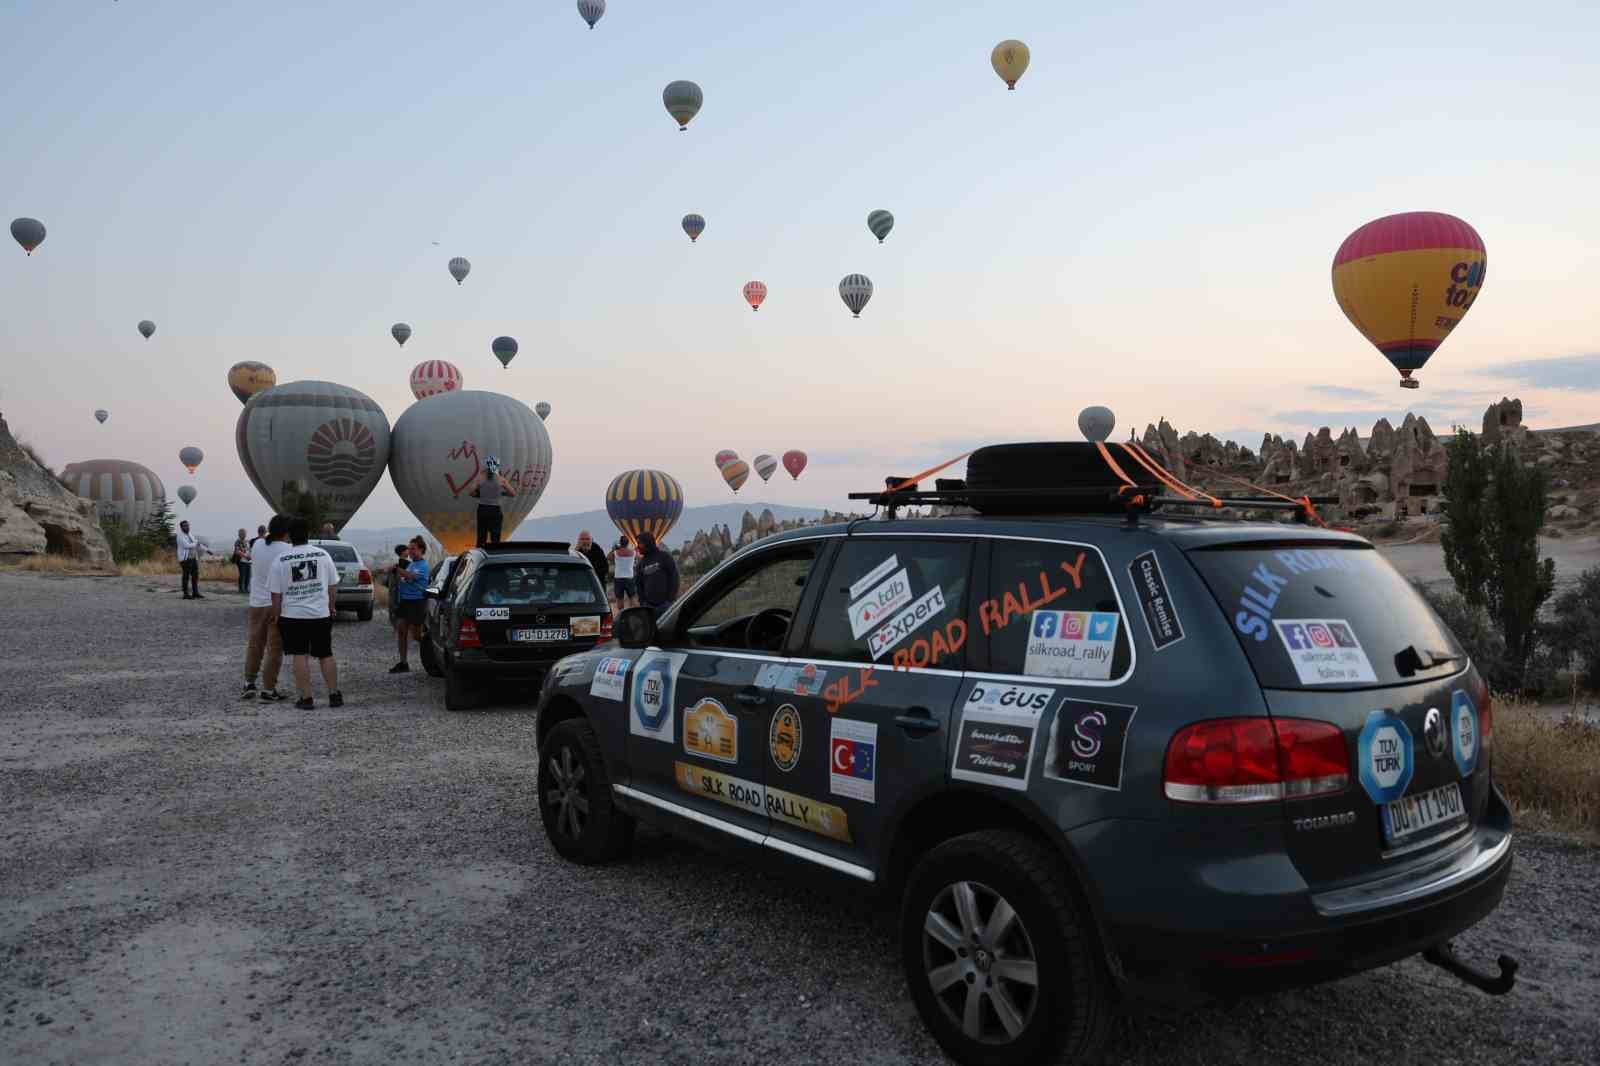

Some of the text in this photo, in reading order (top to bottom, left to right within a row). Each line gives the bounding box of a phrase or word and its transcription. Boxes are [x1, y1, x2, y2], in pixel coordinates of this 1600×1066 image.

[1140, 560, 1159, 597] Classic
[1152, 596, 1173, 637] Remise
[1235, 561, 1288, 641] SILK
[823, 664, 881, 713] SILK
[892, 618, 967, 671] ROAD
[979, 551, 1086, 636] RALLY
[1029, 642, 1110, 662] silkroad_rally
[1068, 760, 1096, 773] SPORT
[702, 774, 809, 824] SILK ROAD RALLY
[1389, 799, 1410, 834] DU
